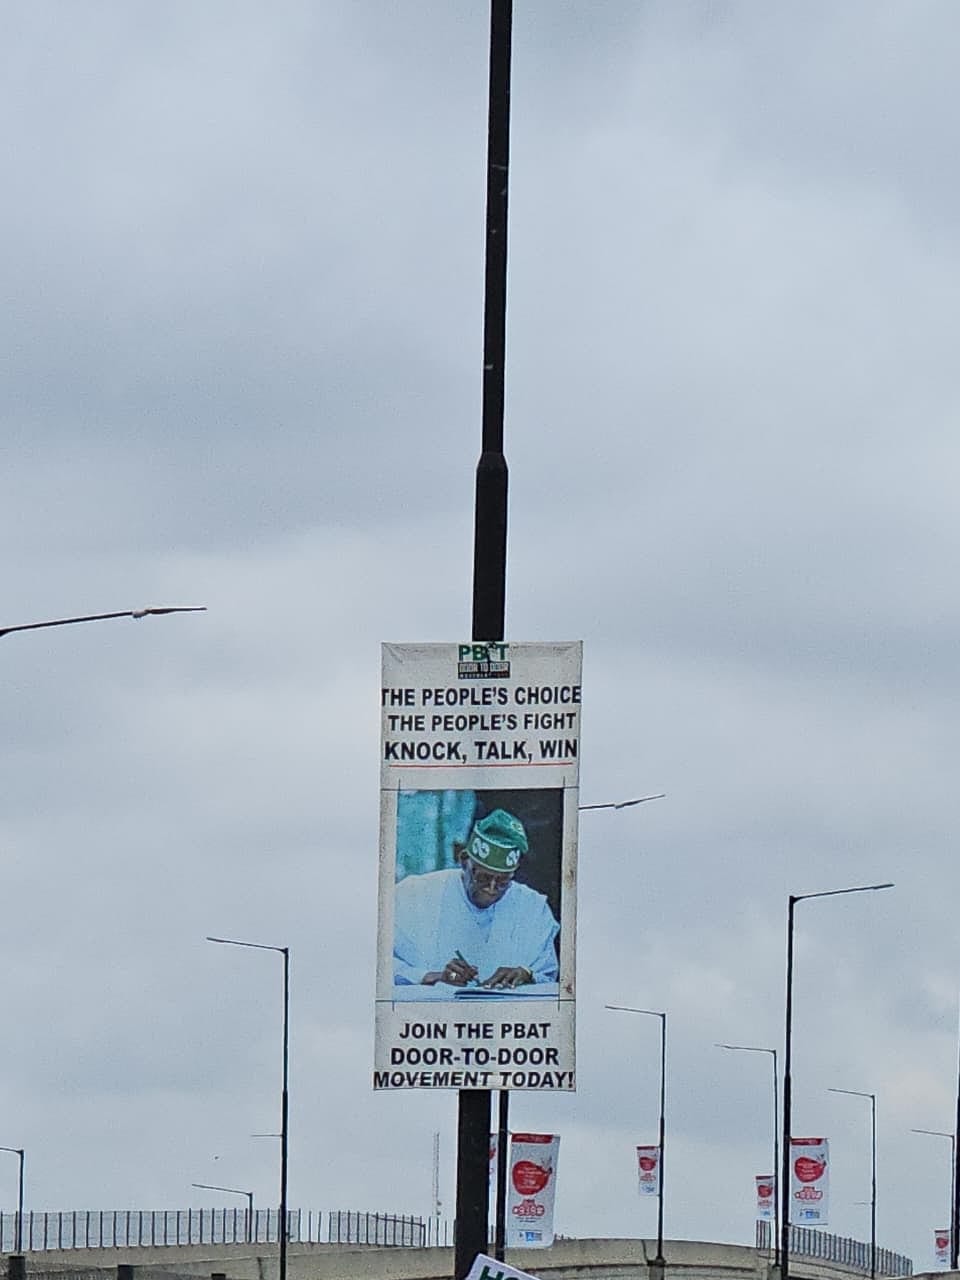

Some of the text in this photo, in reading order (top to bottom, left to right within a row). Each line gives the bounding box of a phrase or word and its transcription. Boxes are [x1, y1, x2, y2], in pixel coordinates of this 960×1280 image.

[382, 685, 582, 706] THE PEOPLE'S CHOICE
[388, 713, 577, 731] THE PEOPLE'S FIGHT
[384, 739, 578, 764] KNOCK, TALK, WIN
[399, 1023, 551, 1039] JOIN THE PBAT
[390, 1048, 559, 1065] DOOR-TO-DOOR
[374, 1071, 574, 1088] MOVEMENT TODAY!
